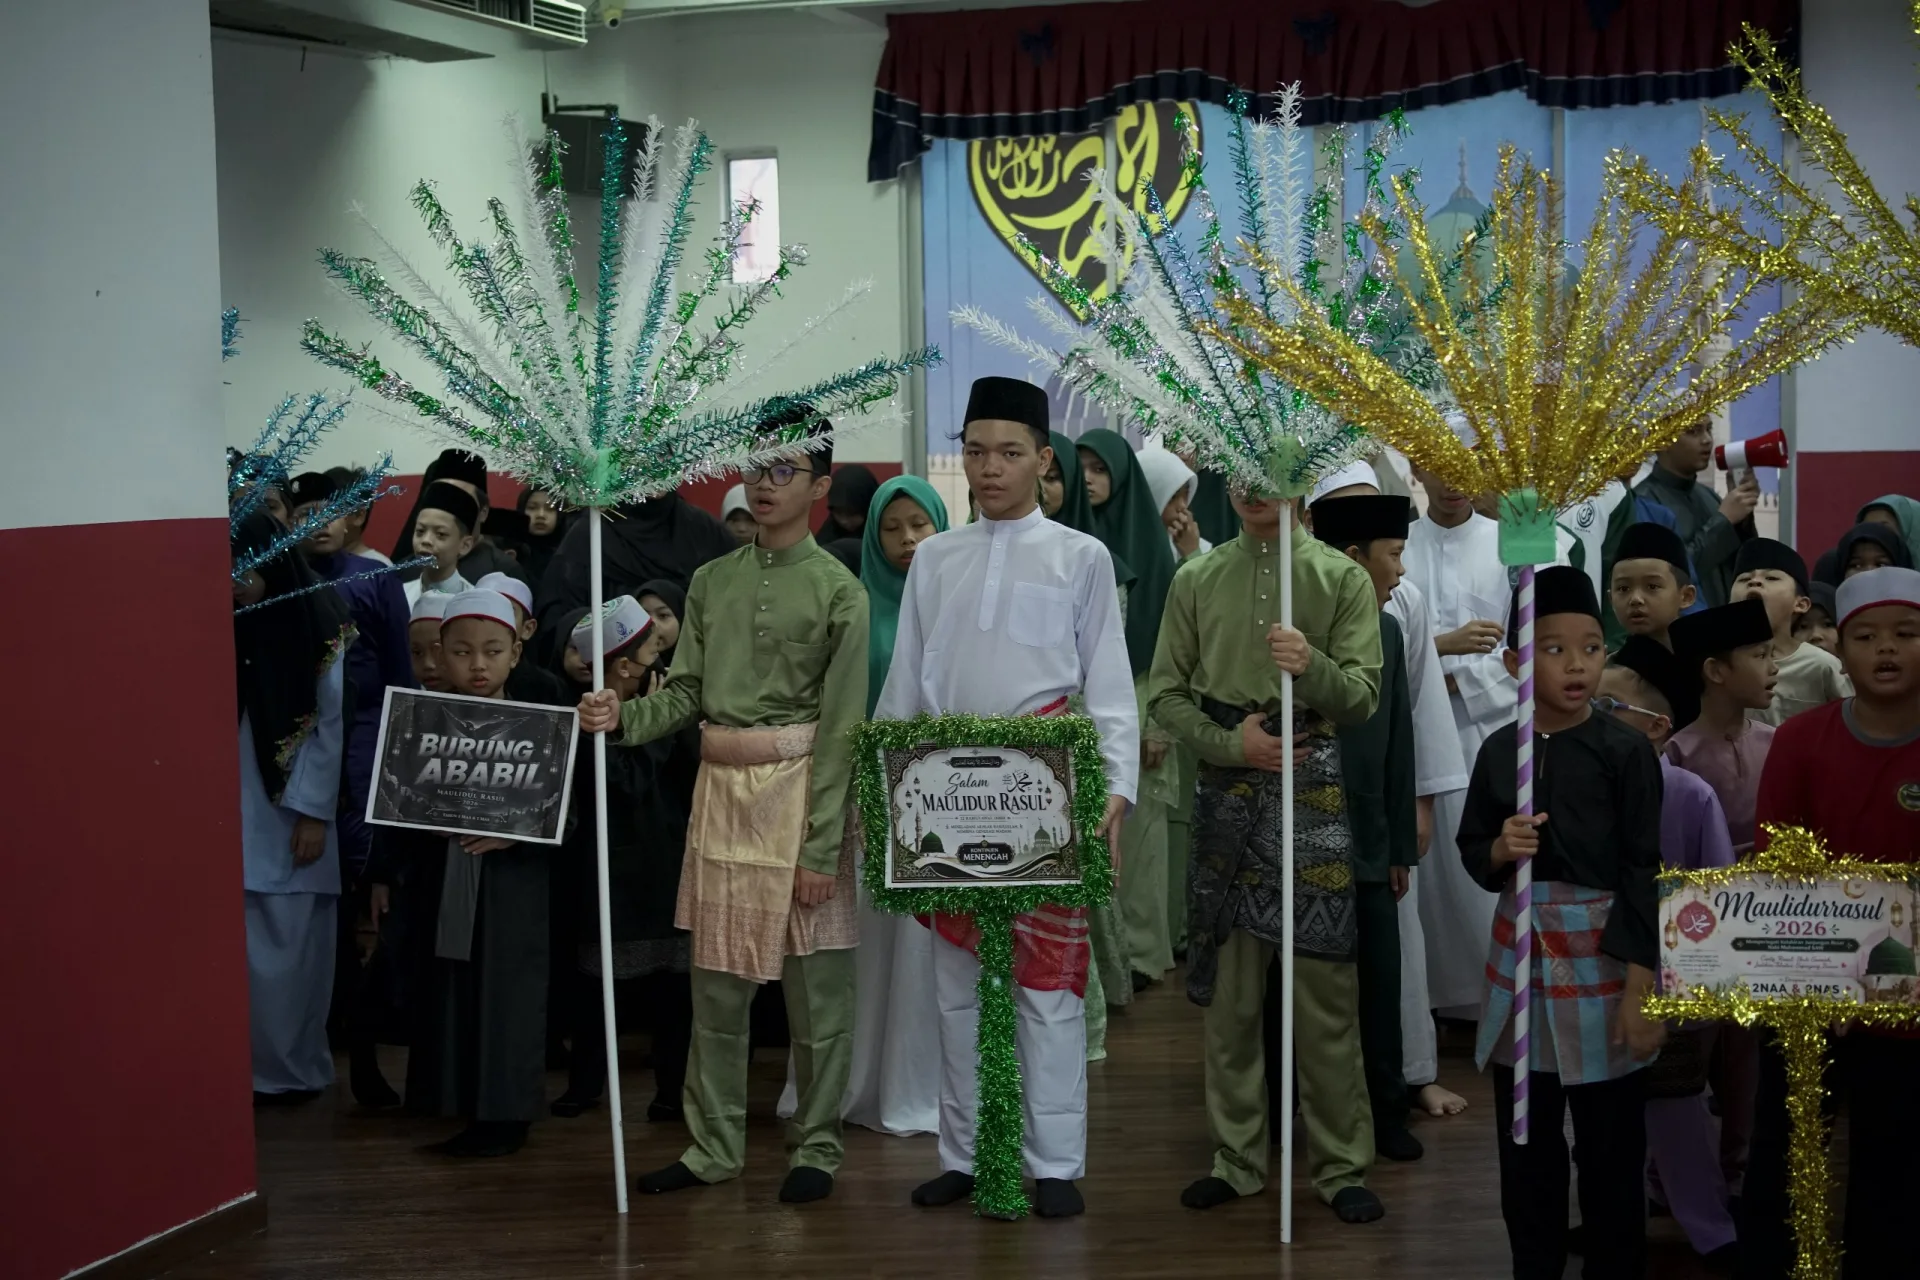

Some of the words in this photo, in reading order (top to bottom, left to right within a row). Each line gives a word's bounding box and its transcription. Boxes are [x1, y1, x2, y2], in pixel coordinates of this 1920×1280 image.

[417, 733, 535, 761] BURUNG
[414, 758, 544, 790] ABABIL
[945, 772, 989, 796] Salam
[480, 793, 505, 802] RASUL
[922, 793, 997, 815] MAULIDUR
[999, 792, 1047, 815] RASUL
[963, 853, 1009, 861] MENENGAH
[1764, 881, 1818, 891] SALAM
[1714, 891, 1885, 923] Maulidurrasul
[1775, 920, 1827, 936] 2026
[1752, 983, 1787, 993] 2NAA
[1792, 983, 1800, 993] &
